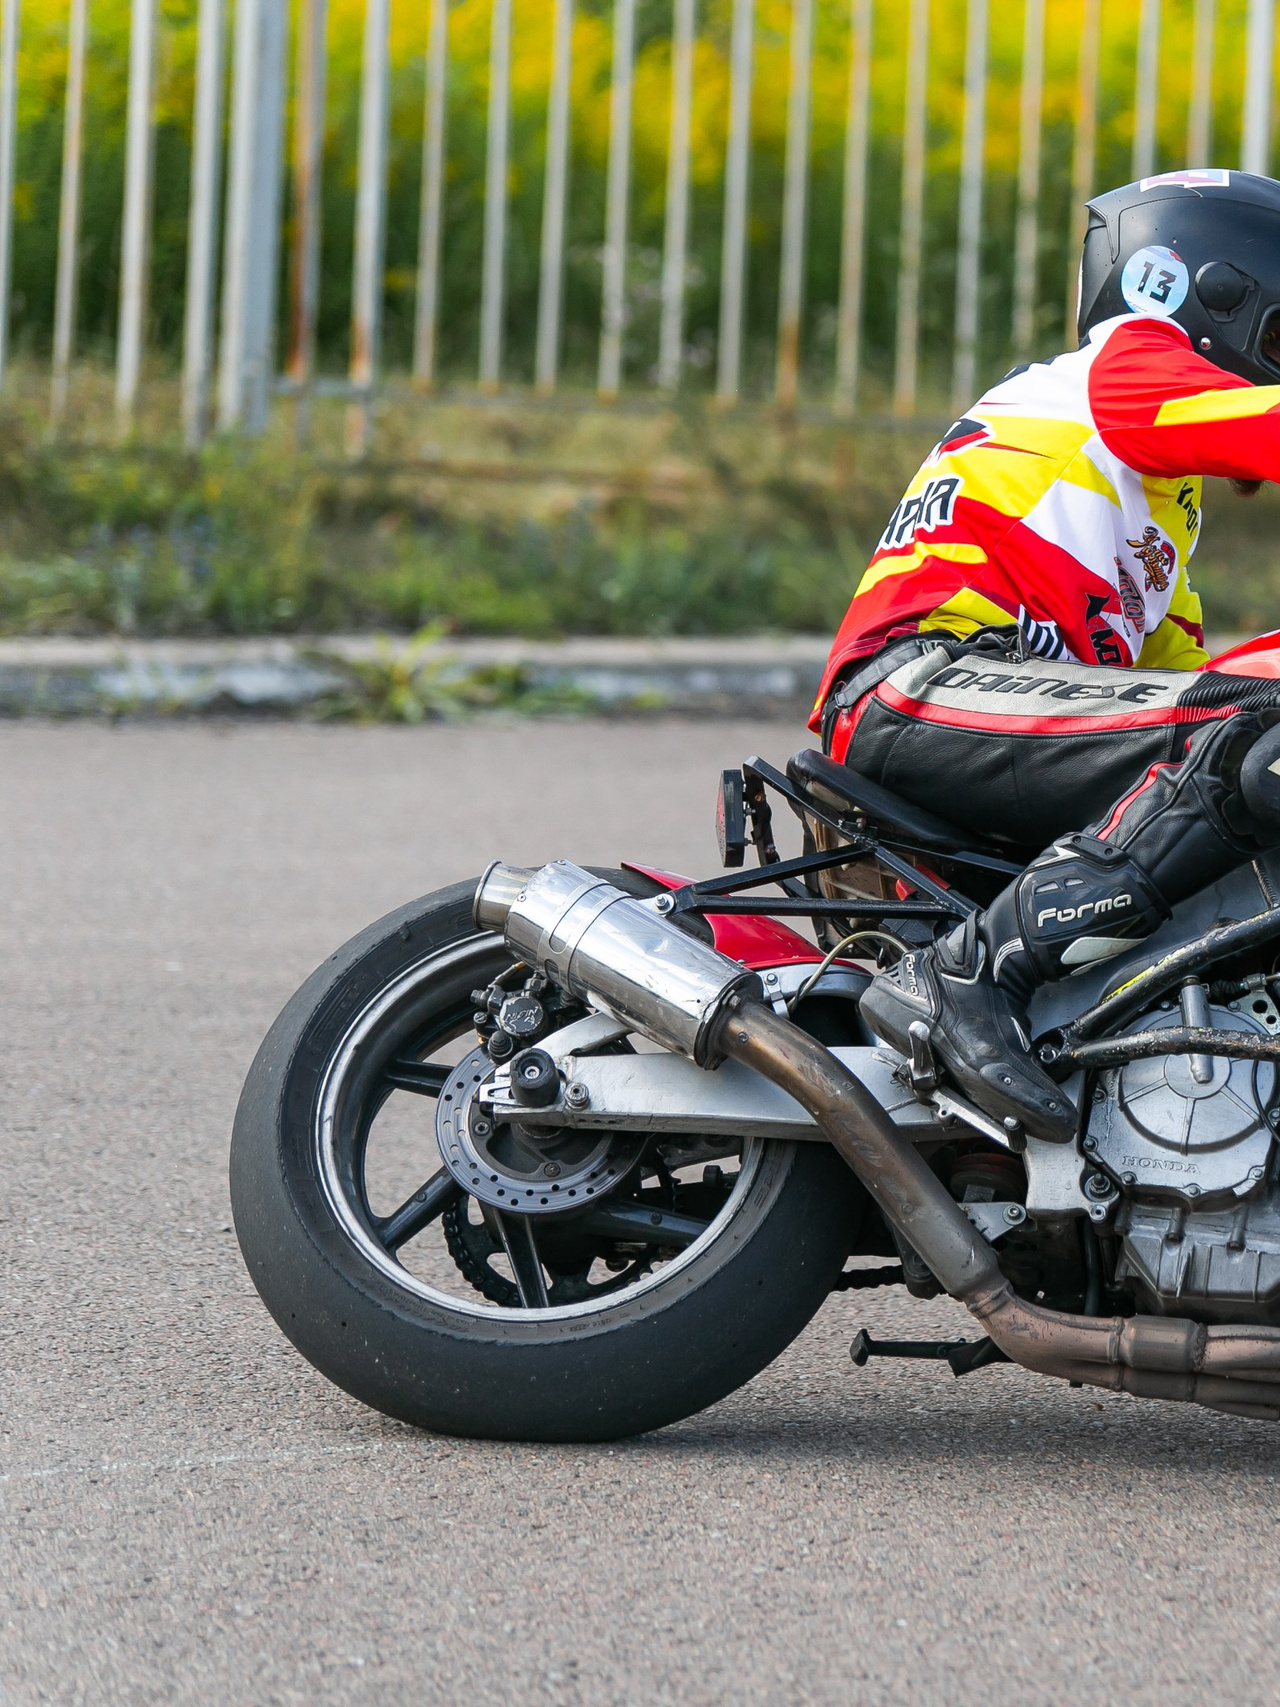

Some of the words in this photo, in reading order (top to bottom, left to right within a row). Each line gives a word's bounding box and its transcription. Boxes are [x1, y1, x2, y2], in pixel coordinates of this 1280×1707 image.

[1137, 261, 1178, 304] 13
[1037, 894, 1132, 928] Forma
[1121, 1155, 1202, 1174] HONDA
